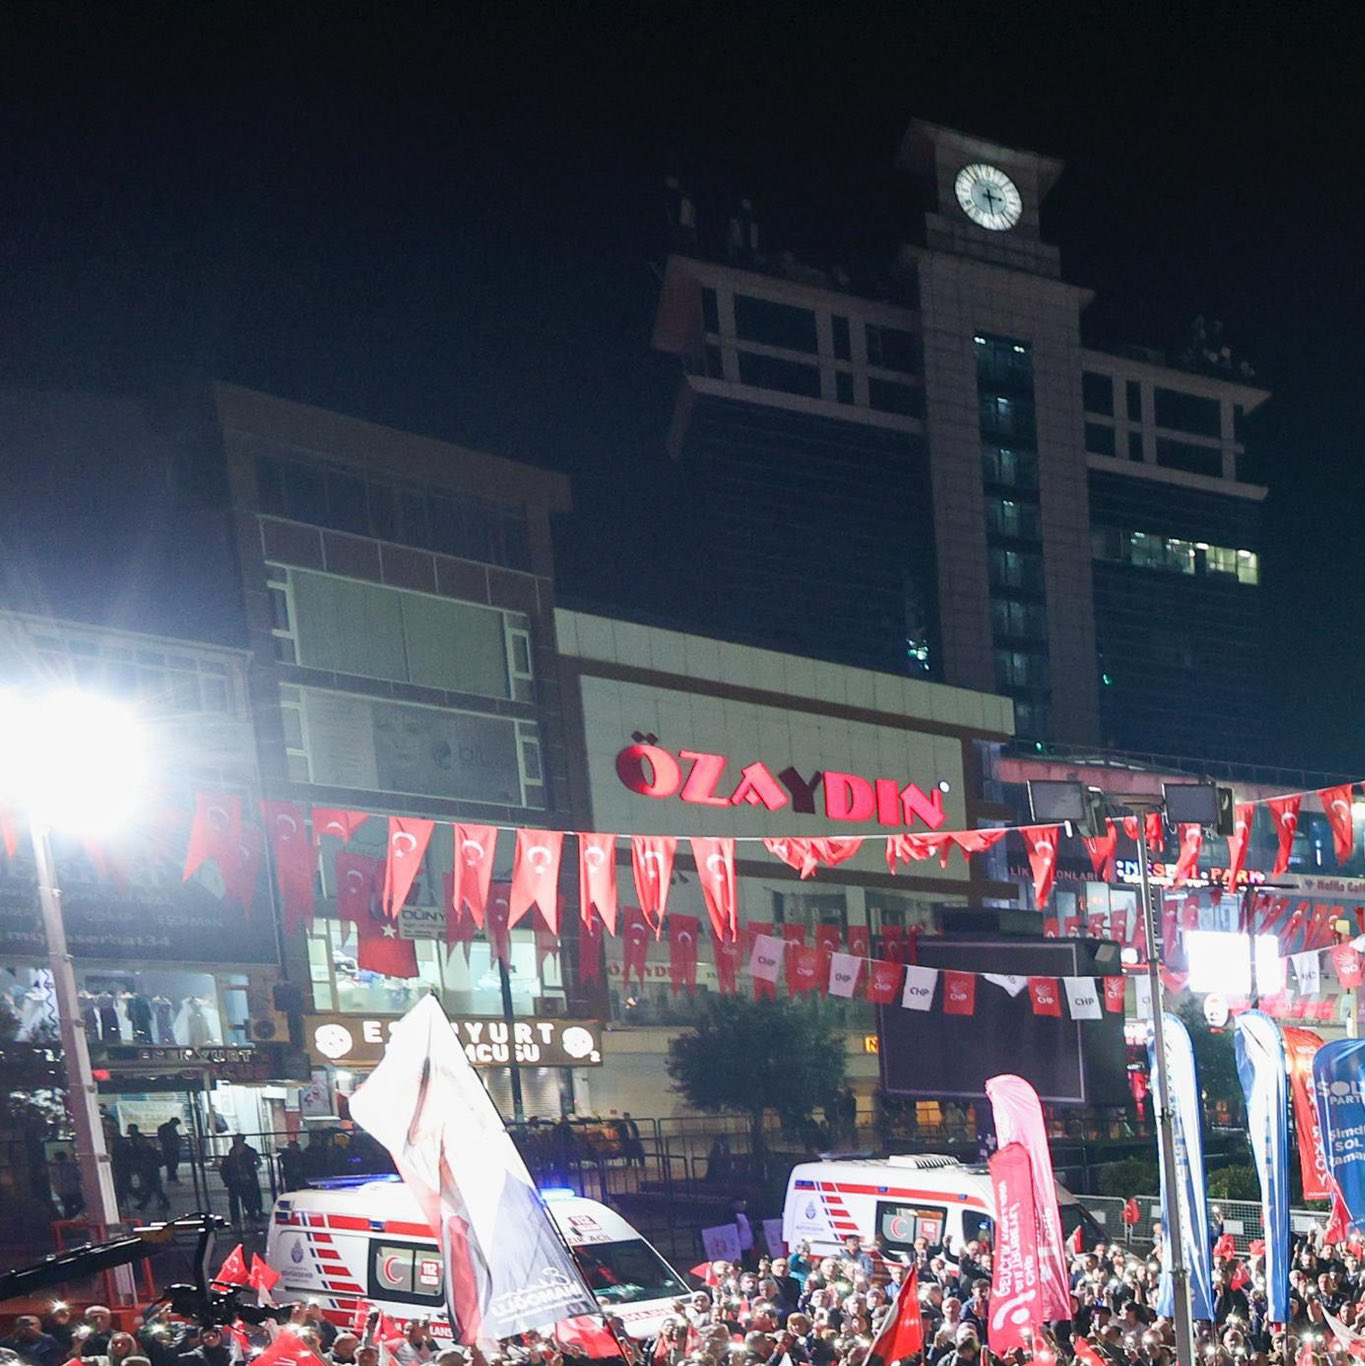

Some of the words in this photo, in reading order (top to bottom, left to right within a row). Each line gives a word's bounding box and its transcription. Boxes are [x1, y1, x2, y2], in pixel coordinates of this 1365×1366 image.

[616, 730, 946, 830] ÖZAYDIN
[401, 909, 447, 922] DÜNY
[757, 956, 777, 967] CHP
[835, 973, 852, 982] CHP
[910, 987, 930, 997] CHP
[1075, 997, 1095, 1007] CHP
[363, 1021, 554, 1043] ESYURT
[1315, 1081, 1361, 1097] SOL
[1335, 1140, 1364, 1151] SOL
[421, 1262, 439, 1277] 112
